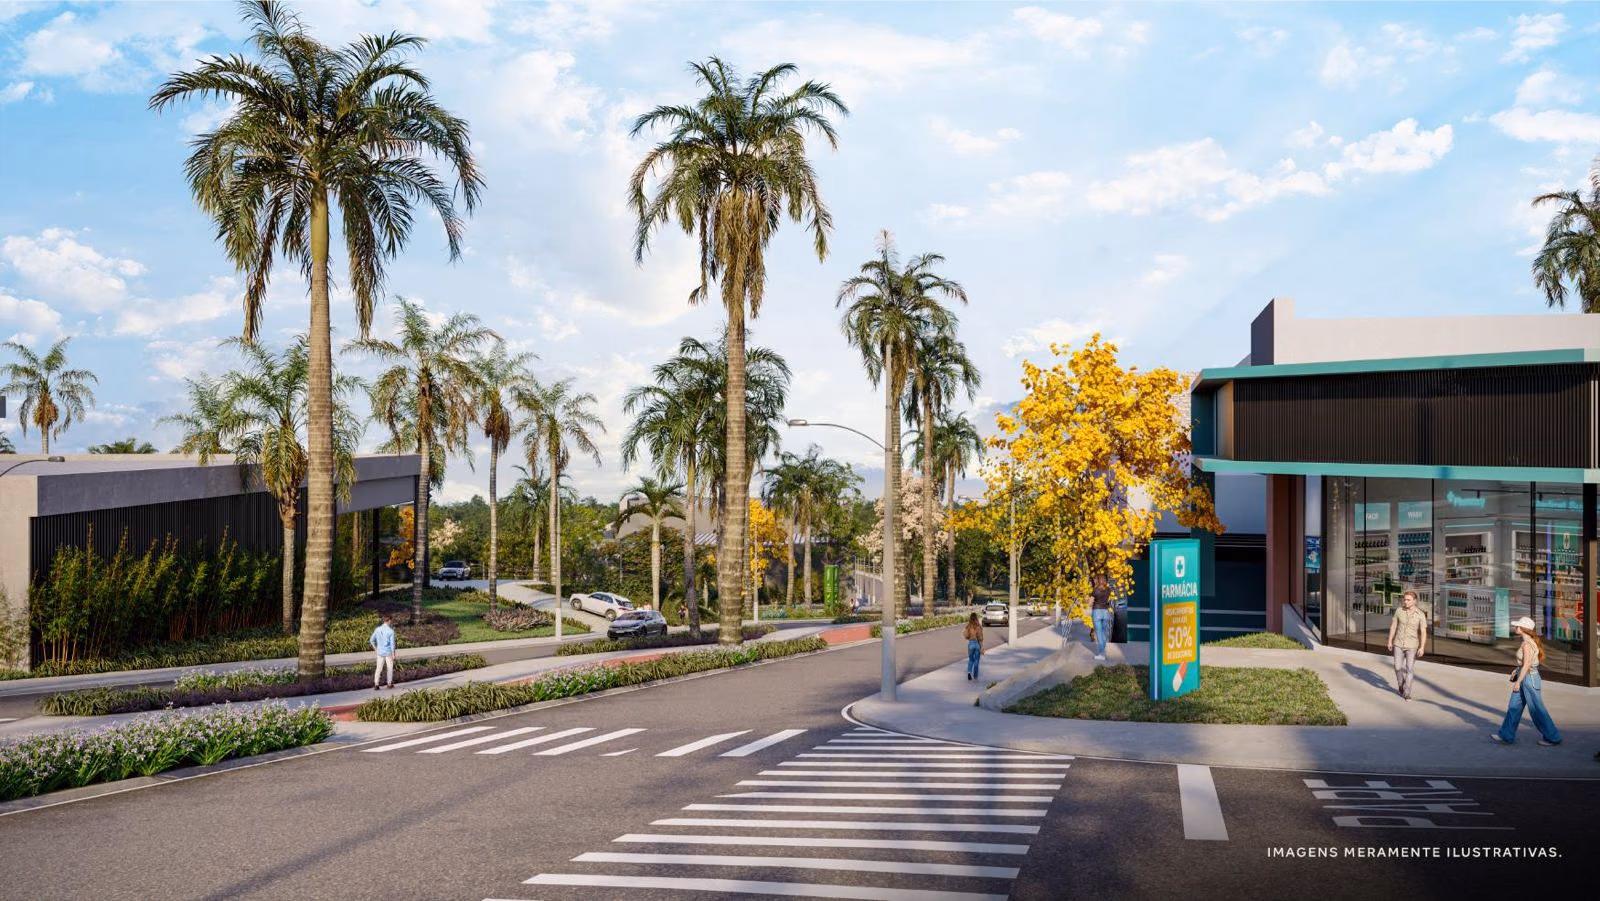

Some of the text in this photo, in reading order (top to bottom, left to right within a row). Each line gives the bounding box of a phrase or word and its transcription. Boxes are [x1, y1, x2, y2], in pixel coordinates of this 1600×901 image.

[1162, 580, 1198, 598] FARMÁCIA
[1168, 625, 1193, 649] 50%
[1303, 779, 1515, 830] PARE
